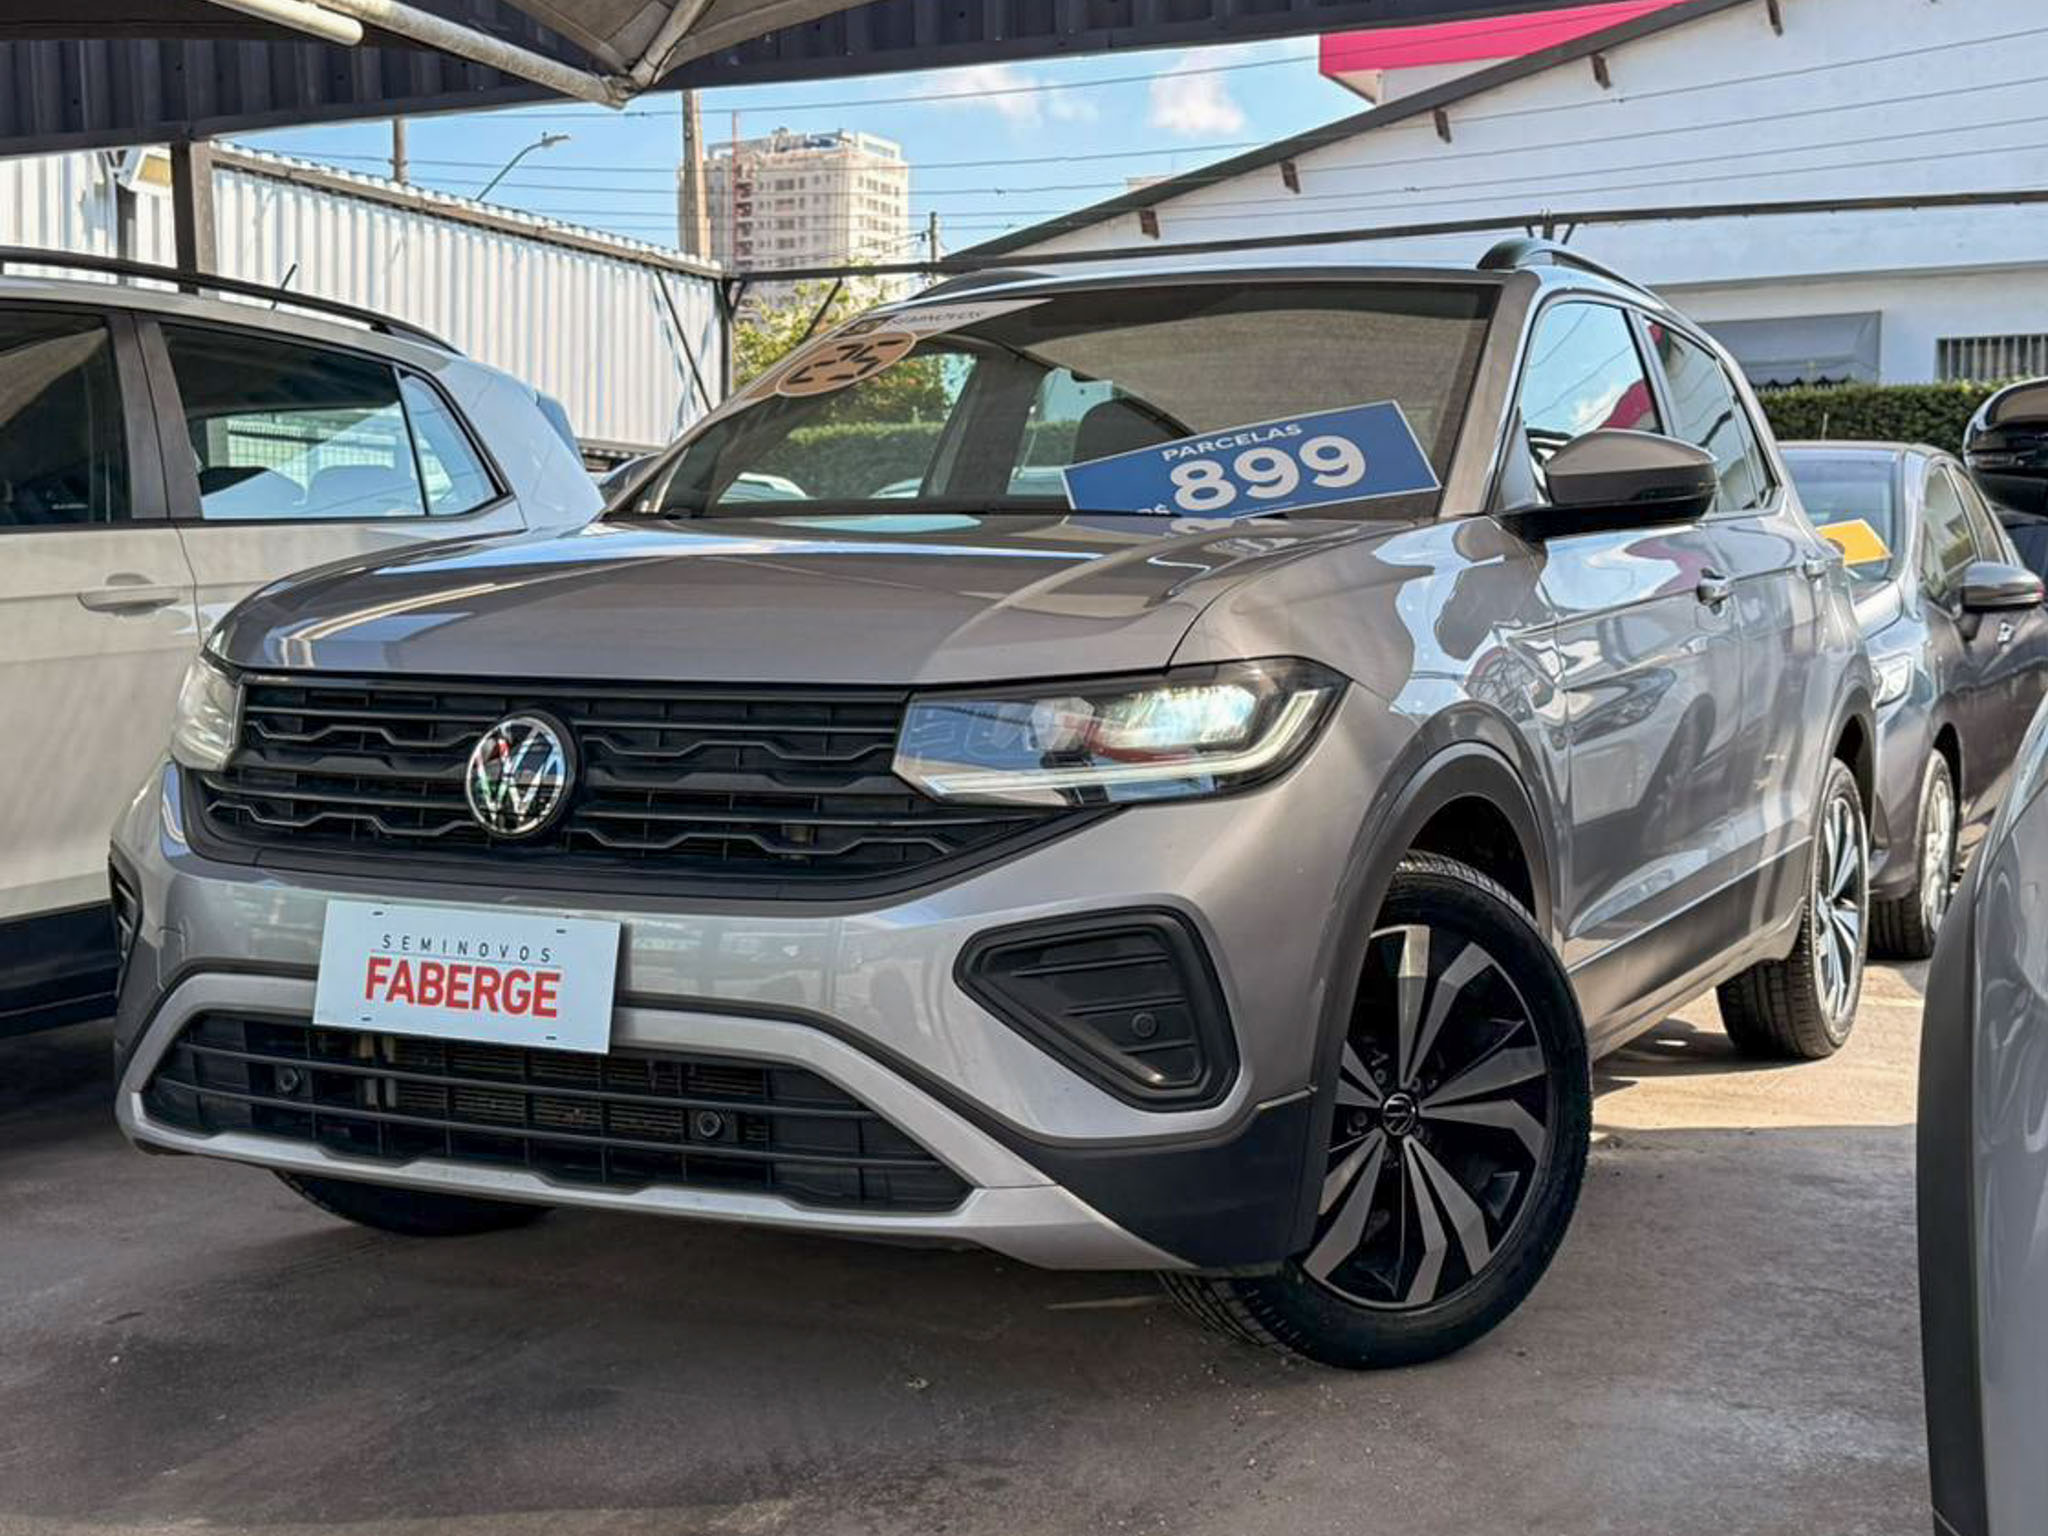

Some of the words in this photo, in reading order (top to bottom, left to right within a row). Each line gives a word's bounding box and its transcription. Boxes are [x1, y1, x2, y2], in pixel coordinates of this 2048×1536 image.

[1162, 423, 1304, 462] PARCELAS
[1169, 435, 1367, 511] 899
[382, 933, 552, 963] SEMINOVOS
[364, 956, 561, 1019] FABERGE
